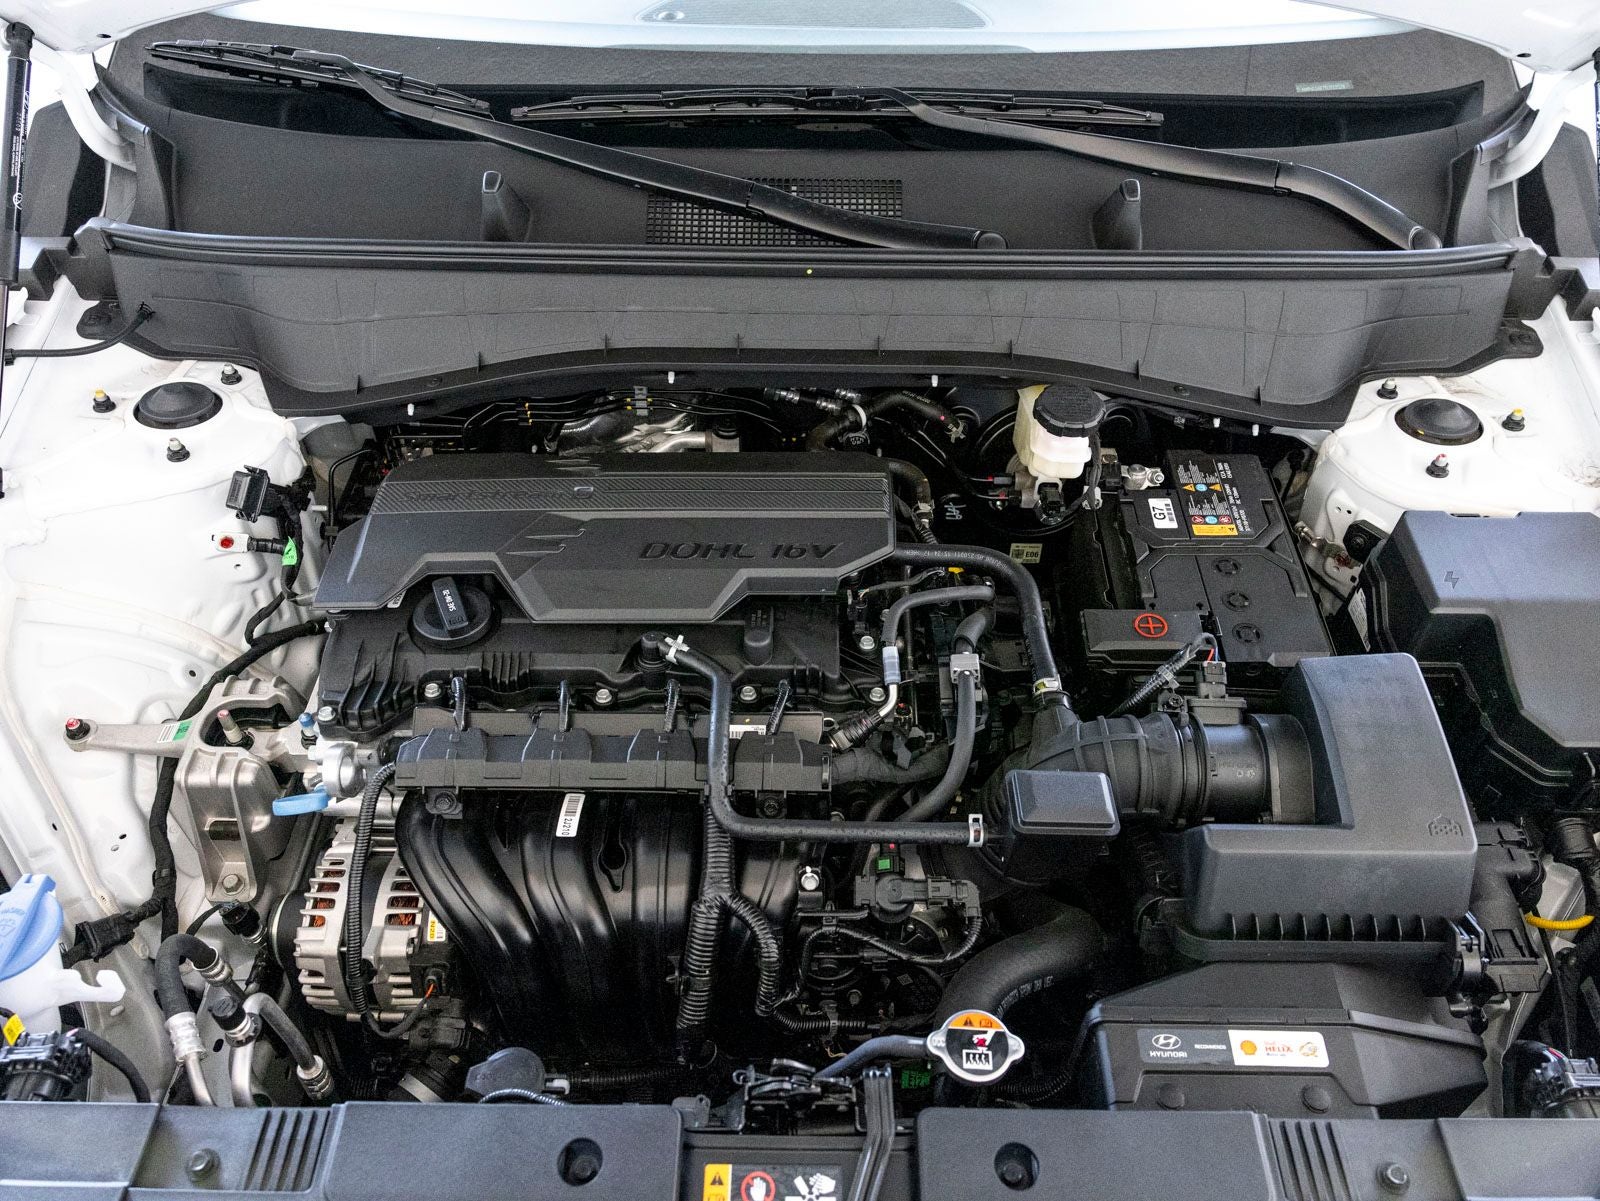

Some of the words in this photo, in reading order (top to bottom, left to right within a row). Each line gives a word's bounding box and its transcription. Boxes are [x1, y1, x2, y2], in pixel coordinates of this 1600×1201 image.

[1152, 506, 1166, 521] G7
[769, 541, 844, 561] 16V
[561, 817, 573, 836] 2J210
[1149, 1050, 1188, 1058] HYUNDAI
